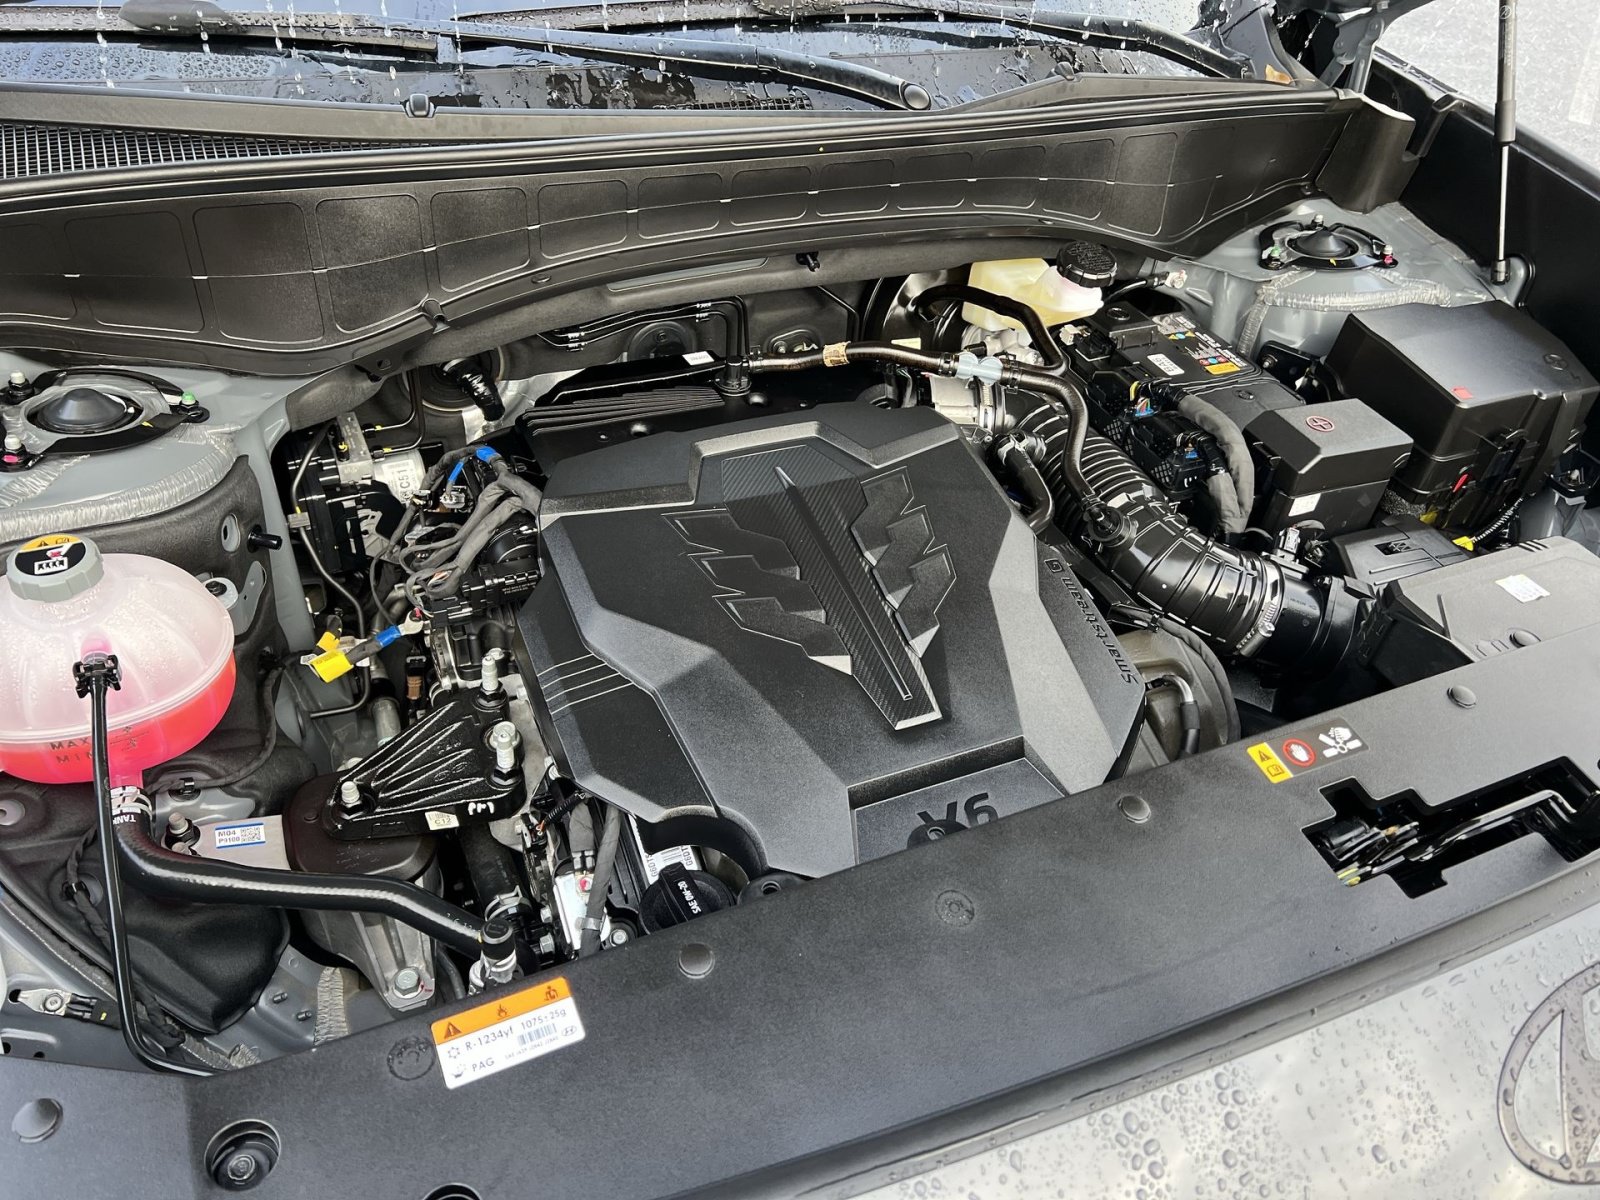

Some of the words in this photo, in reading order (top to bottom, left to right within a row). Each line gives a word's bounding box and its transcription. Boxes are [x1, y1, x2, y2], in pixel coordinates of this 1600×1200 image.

[397, 469, 411, 489] C51
[1061, 576, 1139, 685] Smartstream
[49, 737, 89, 751] MAX
[434, 817, 452, 825] C12
[217, 829, 237, 838] M04
[677, 880, 695, 901] 0W-20
[688, 899, 702, 914] SAE
[464, 1026, 514, 1051] R-1234yf
[471, 1057, 495, 1072] PAG
